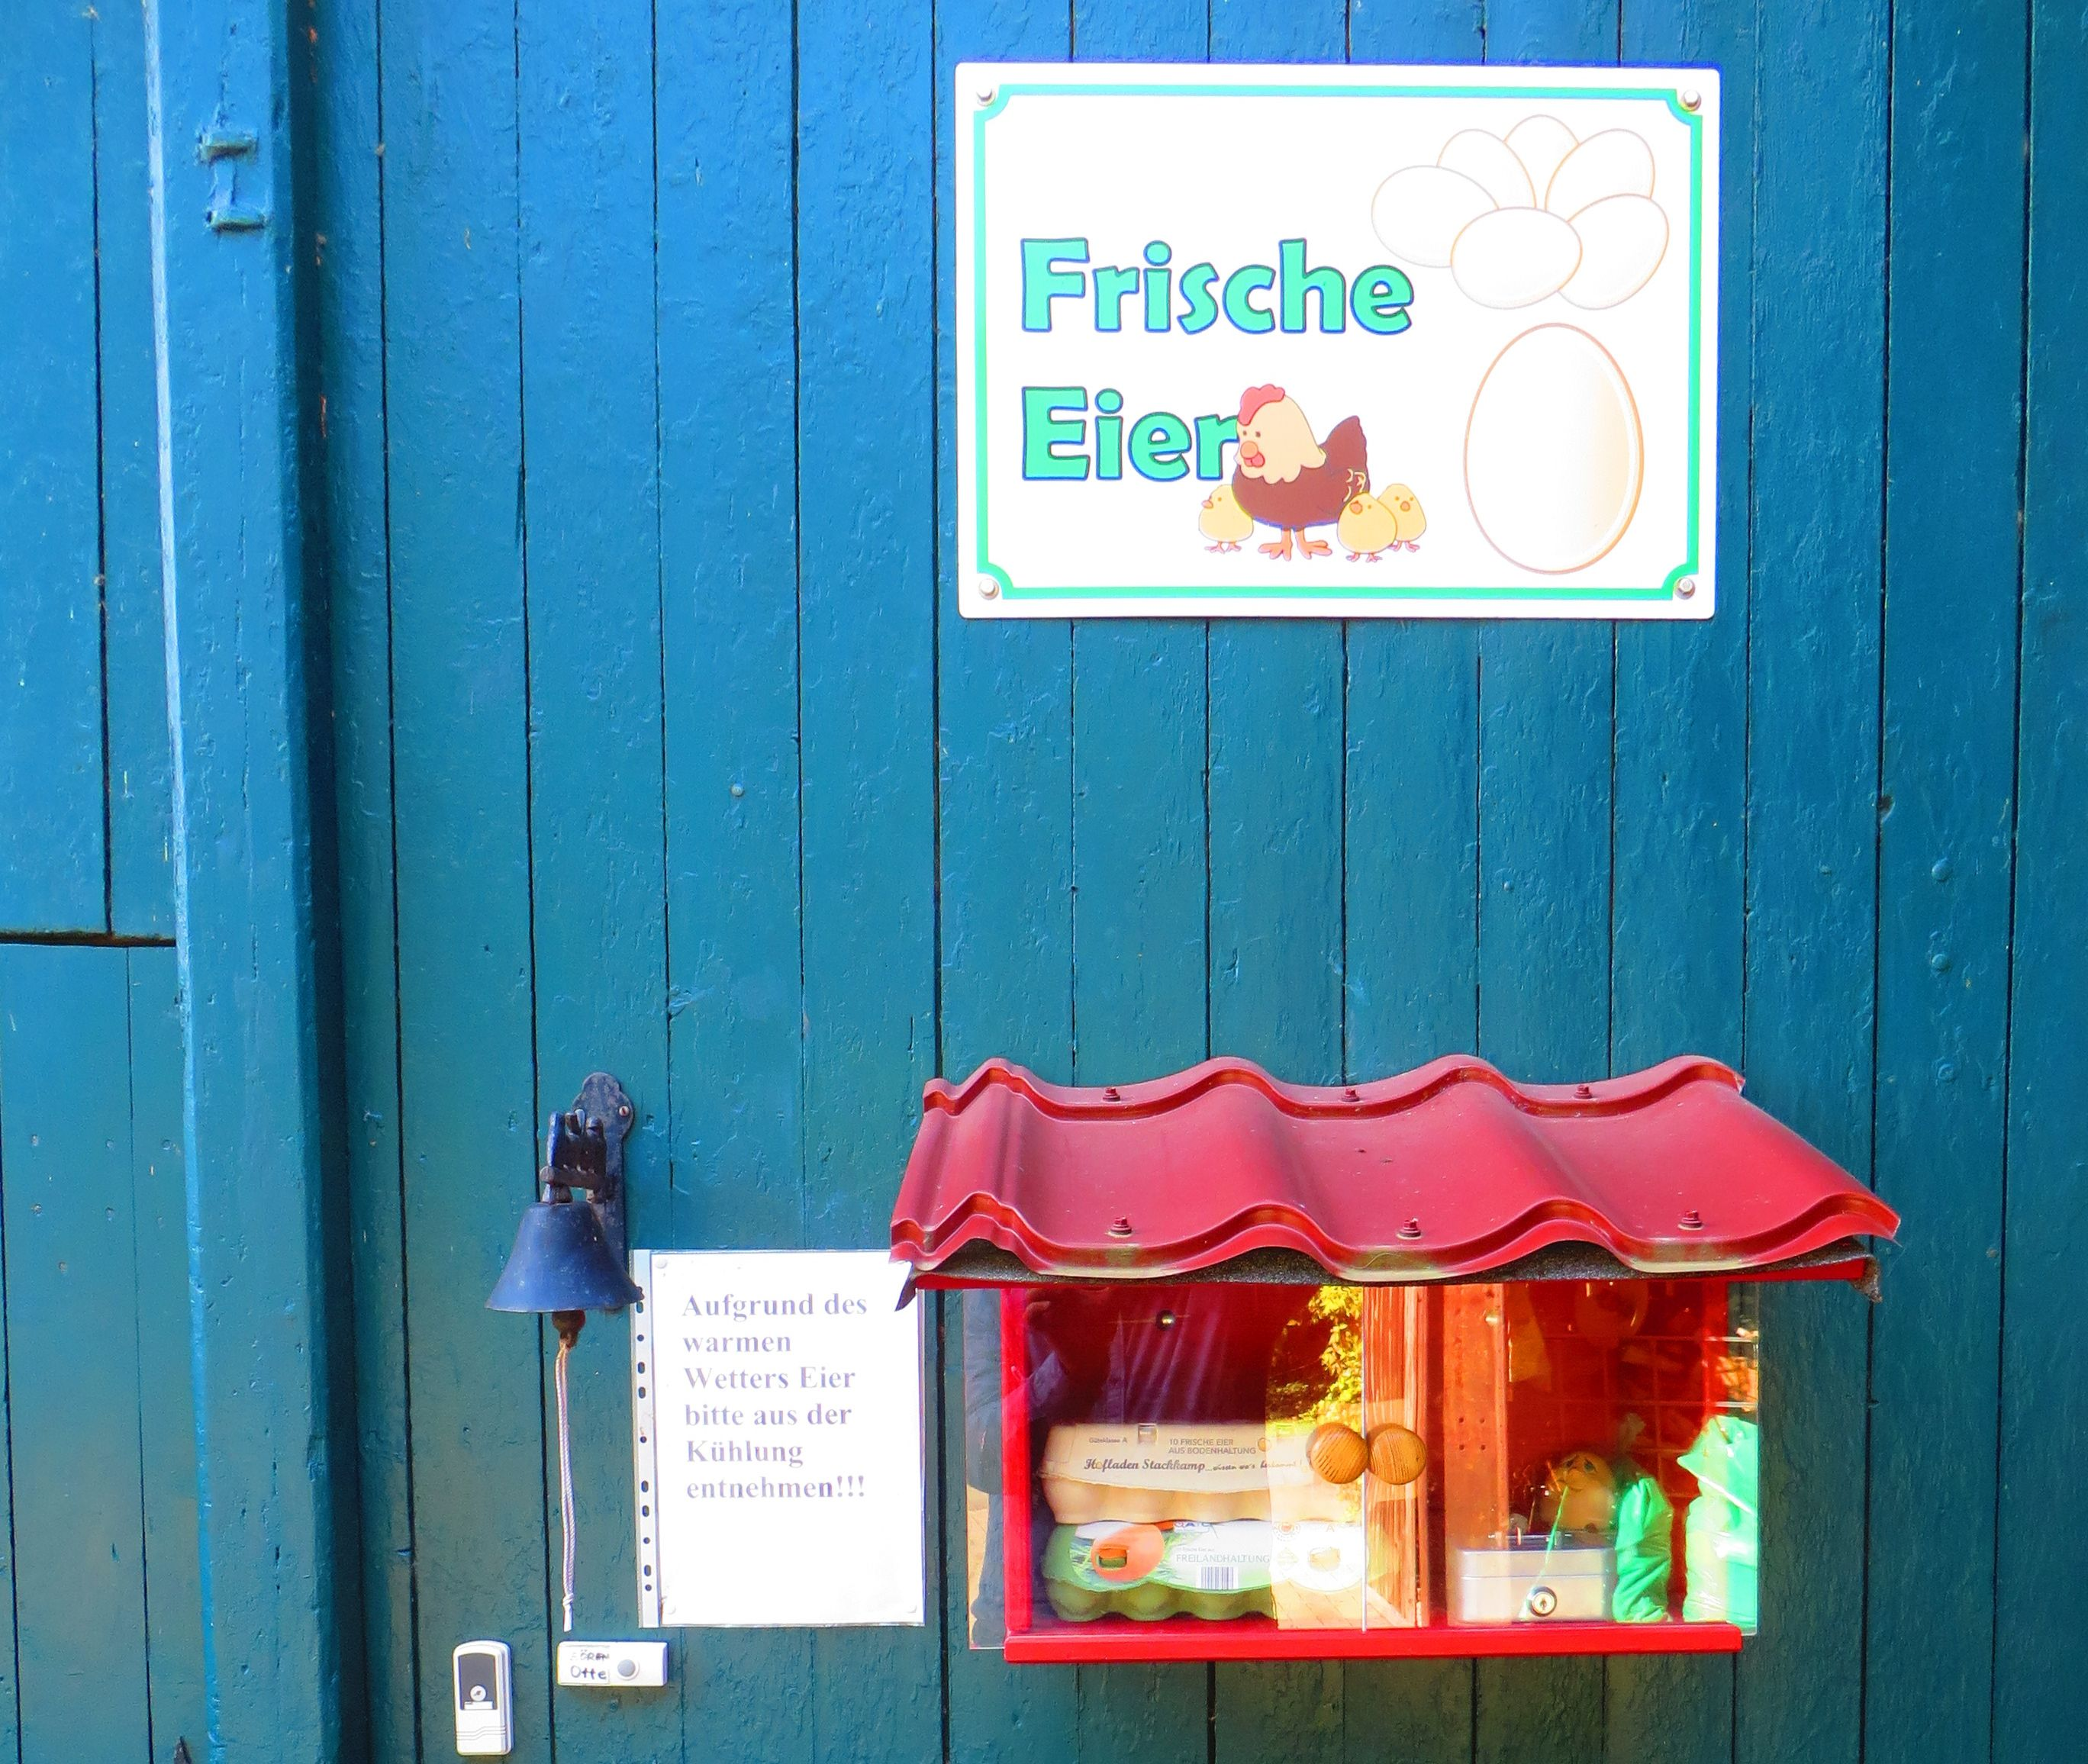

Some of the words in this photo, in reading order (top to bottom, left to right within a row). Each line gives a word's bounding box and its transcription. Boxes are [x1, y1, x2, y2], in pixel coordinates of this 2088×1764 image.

[1020, 237, 1414, 335] Frische
[1021, 385, 1239, 481] Eier
[682, 1293, 814, 1322] Aufgrund
[824, 1292, 868, 1315] des
[682, 1336, 791, 1353] warmen
[684, 1366, 789, 1389] Wetters
[799, 1366, 856, 1389] Eier
[685, 1404, 743, 1426] bitte
[754, 1410, 798, 1426] aus
[807, 1403, 852, 1425] der
[686, 1440, 804, 1468] Kühlung
[1084, 1458, 1139, 1473] Hofladen
[687, 1475, 865, 1498] entnehmen!!!
[1176, 1553, 1270, 1563] FREILANDHALTUNG
[570, 1665, 607, 1680] Otte
